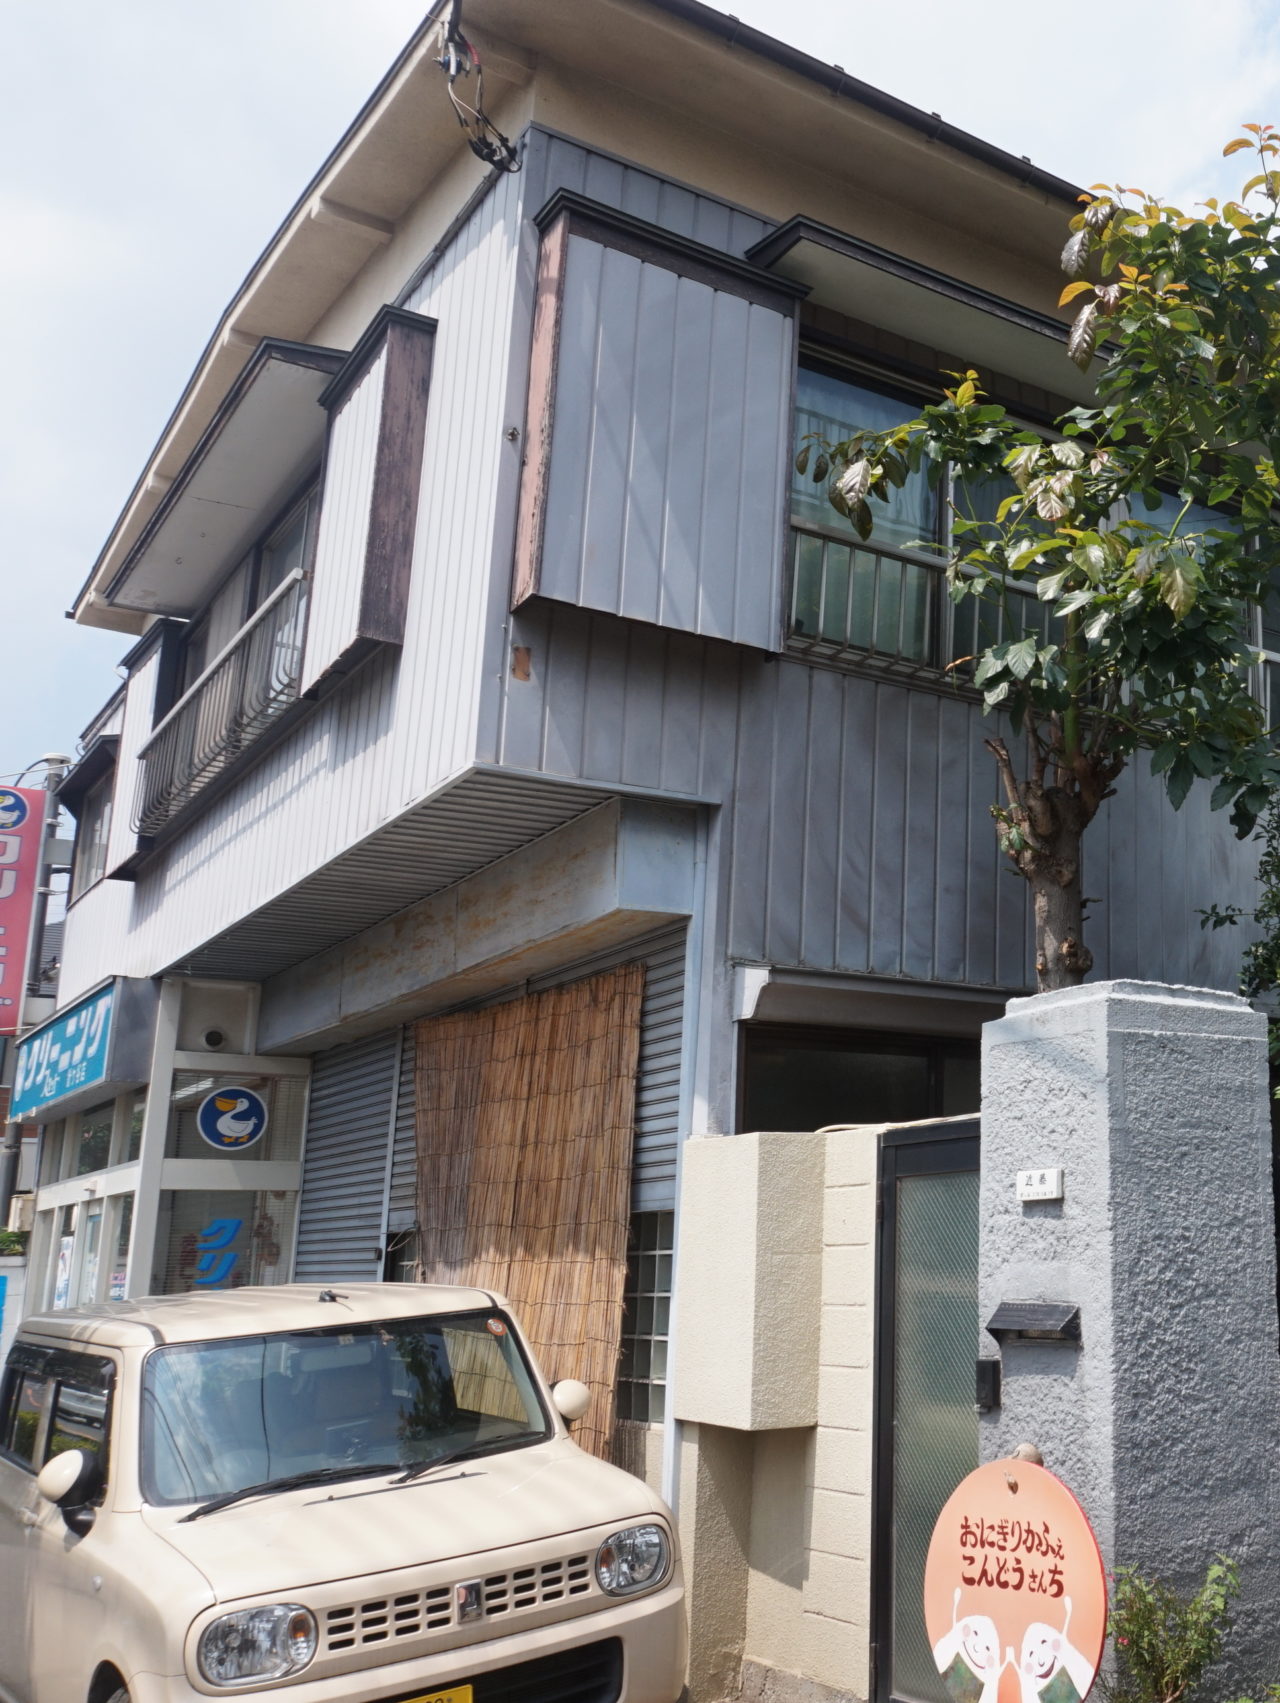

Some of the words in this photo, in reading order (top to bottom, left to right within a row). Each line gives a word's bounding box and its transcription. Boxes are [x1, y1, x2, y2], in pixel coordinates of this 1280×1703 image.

[24, 994, 112, 1091] クリーニング
[194, 1218, 243, 1291] クリ
[960, 1516, 1064, 1560] おにぎりかふぇ
